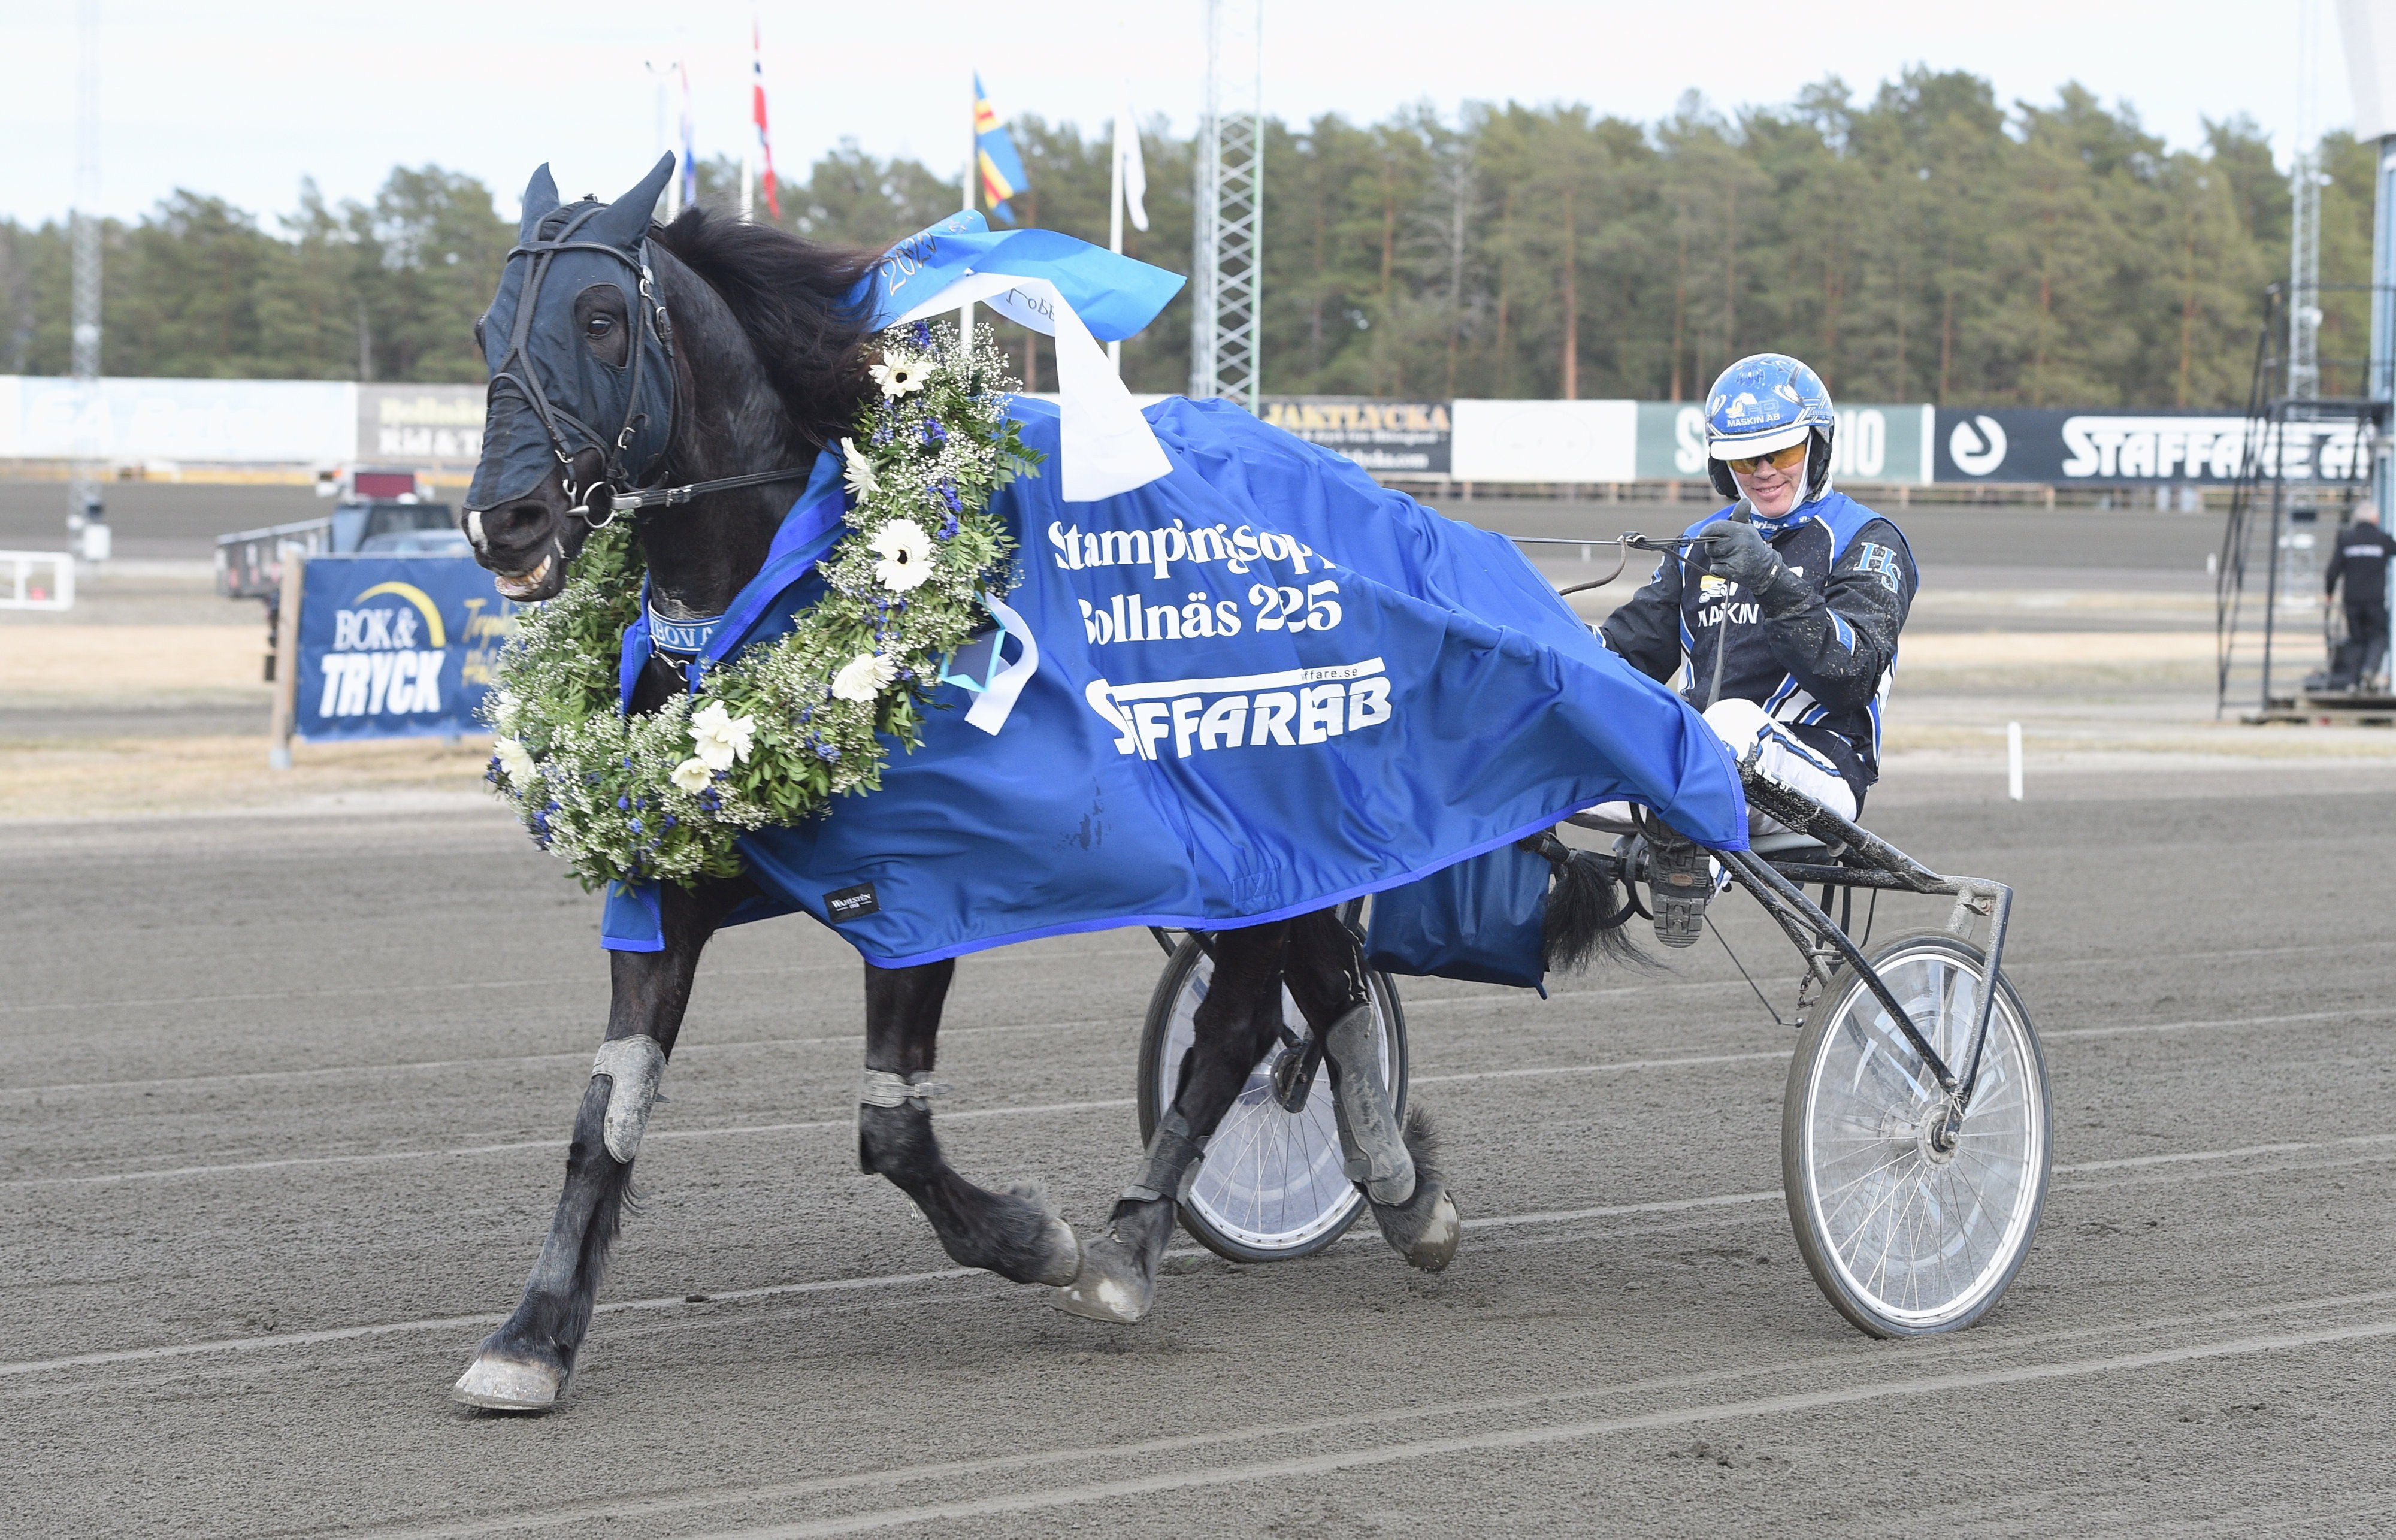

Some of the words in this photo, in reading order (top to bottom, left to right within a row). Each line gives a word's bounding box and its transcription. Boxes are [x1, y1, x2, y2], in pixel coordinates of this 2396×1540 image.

[1726, 416, 1764, 428] MASKIN
[1766, 413, 1780, 422] AB
[1048, 519, 1336, 579] Stampingsop
[333, 609, 394, 651] BOK
[392, 607, 418, 648] &
[319, 651, 446, 718] TRYCK
